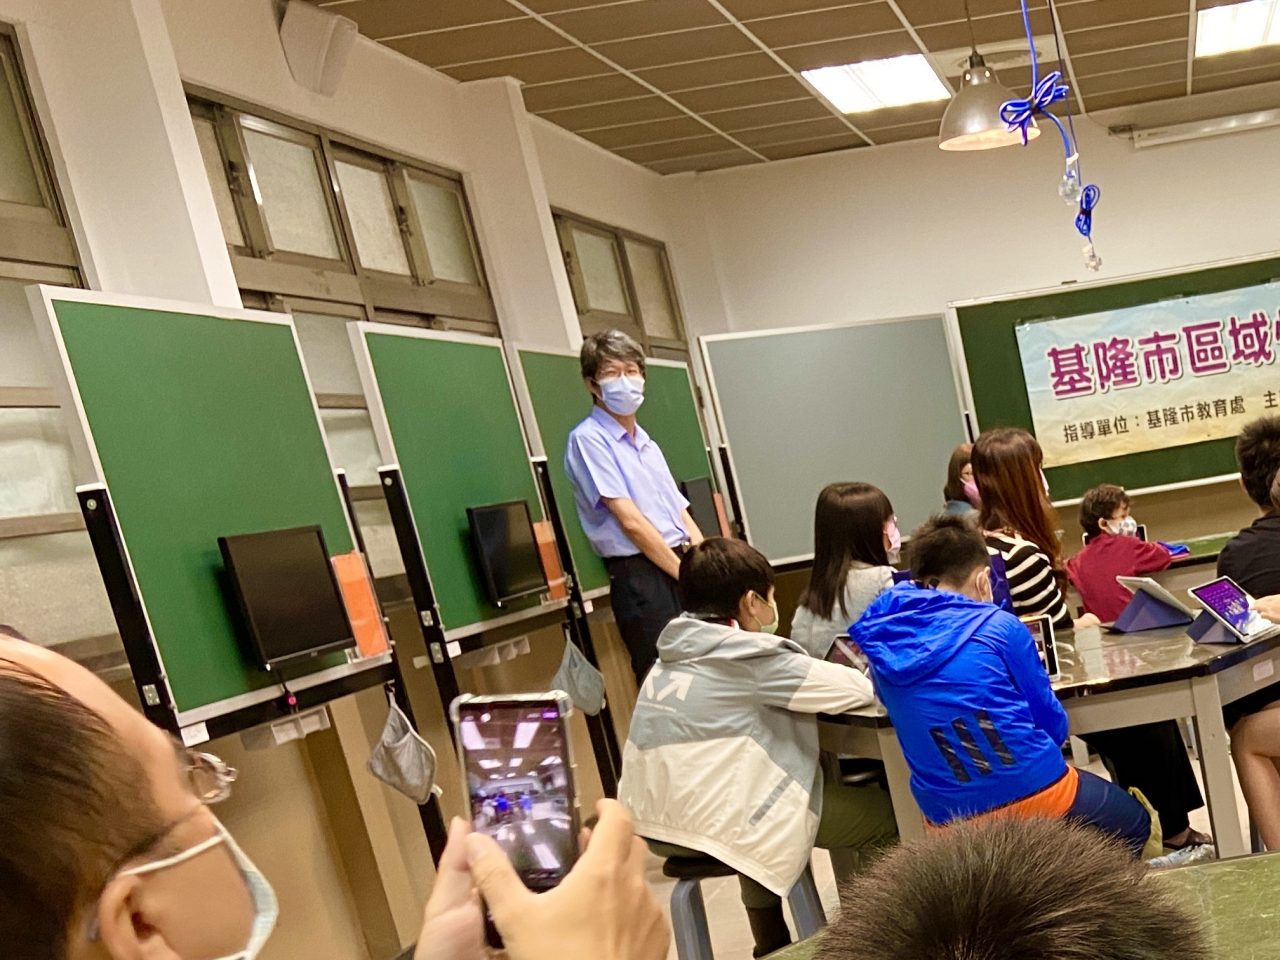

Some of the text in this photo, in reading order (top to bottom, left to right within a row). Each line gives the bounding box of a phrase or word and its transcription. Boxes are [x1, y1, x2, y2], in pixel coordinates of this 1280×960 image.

[1063, 395, 1246, 443] 指導單位：基隆市教育處
